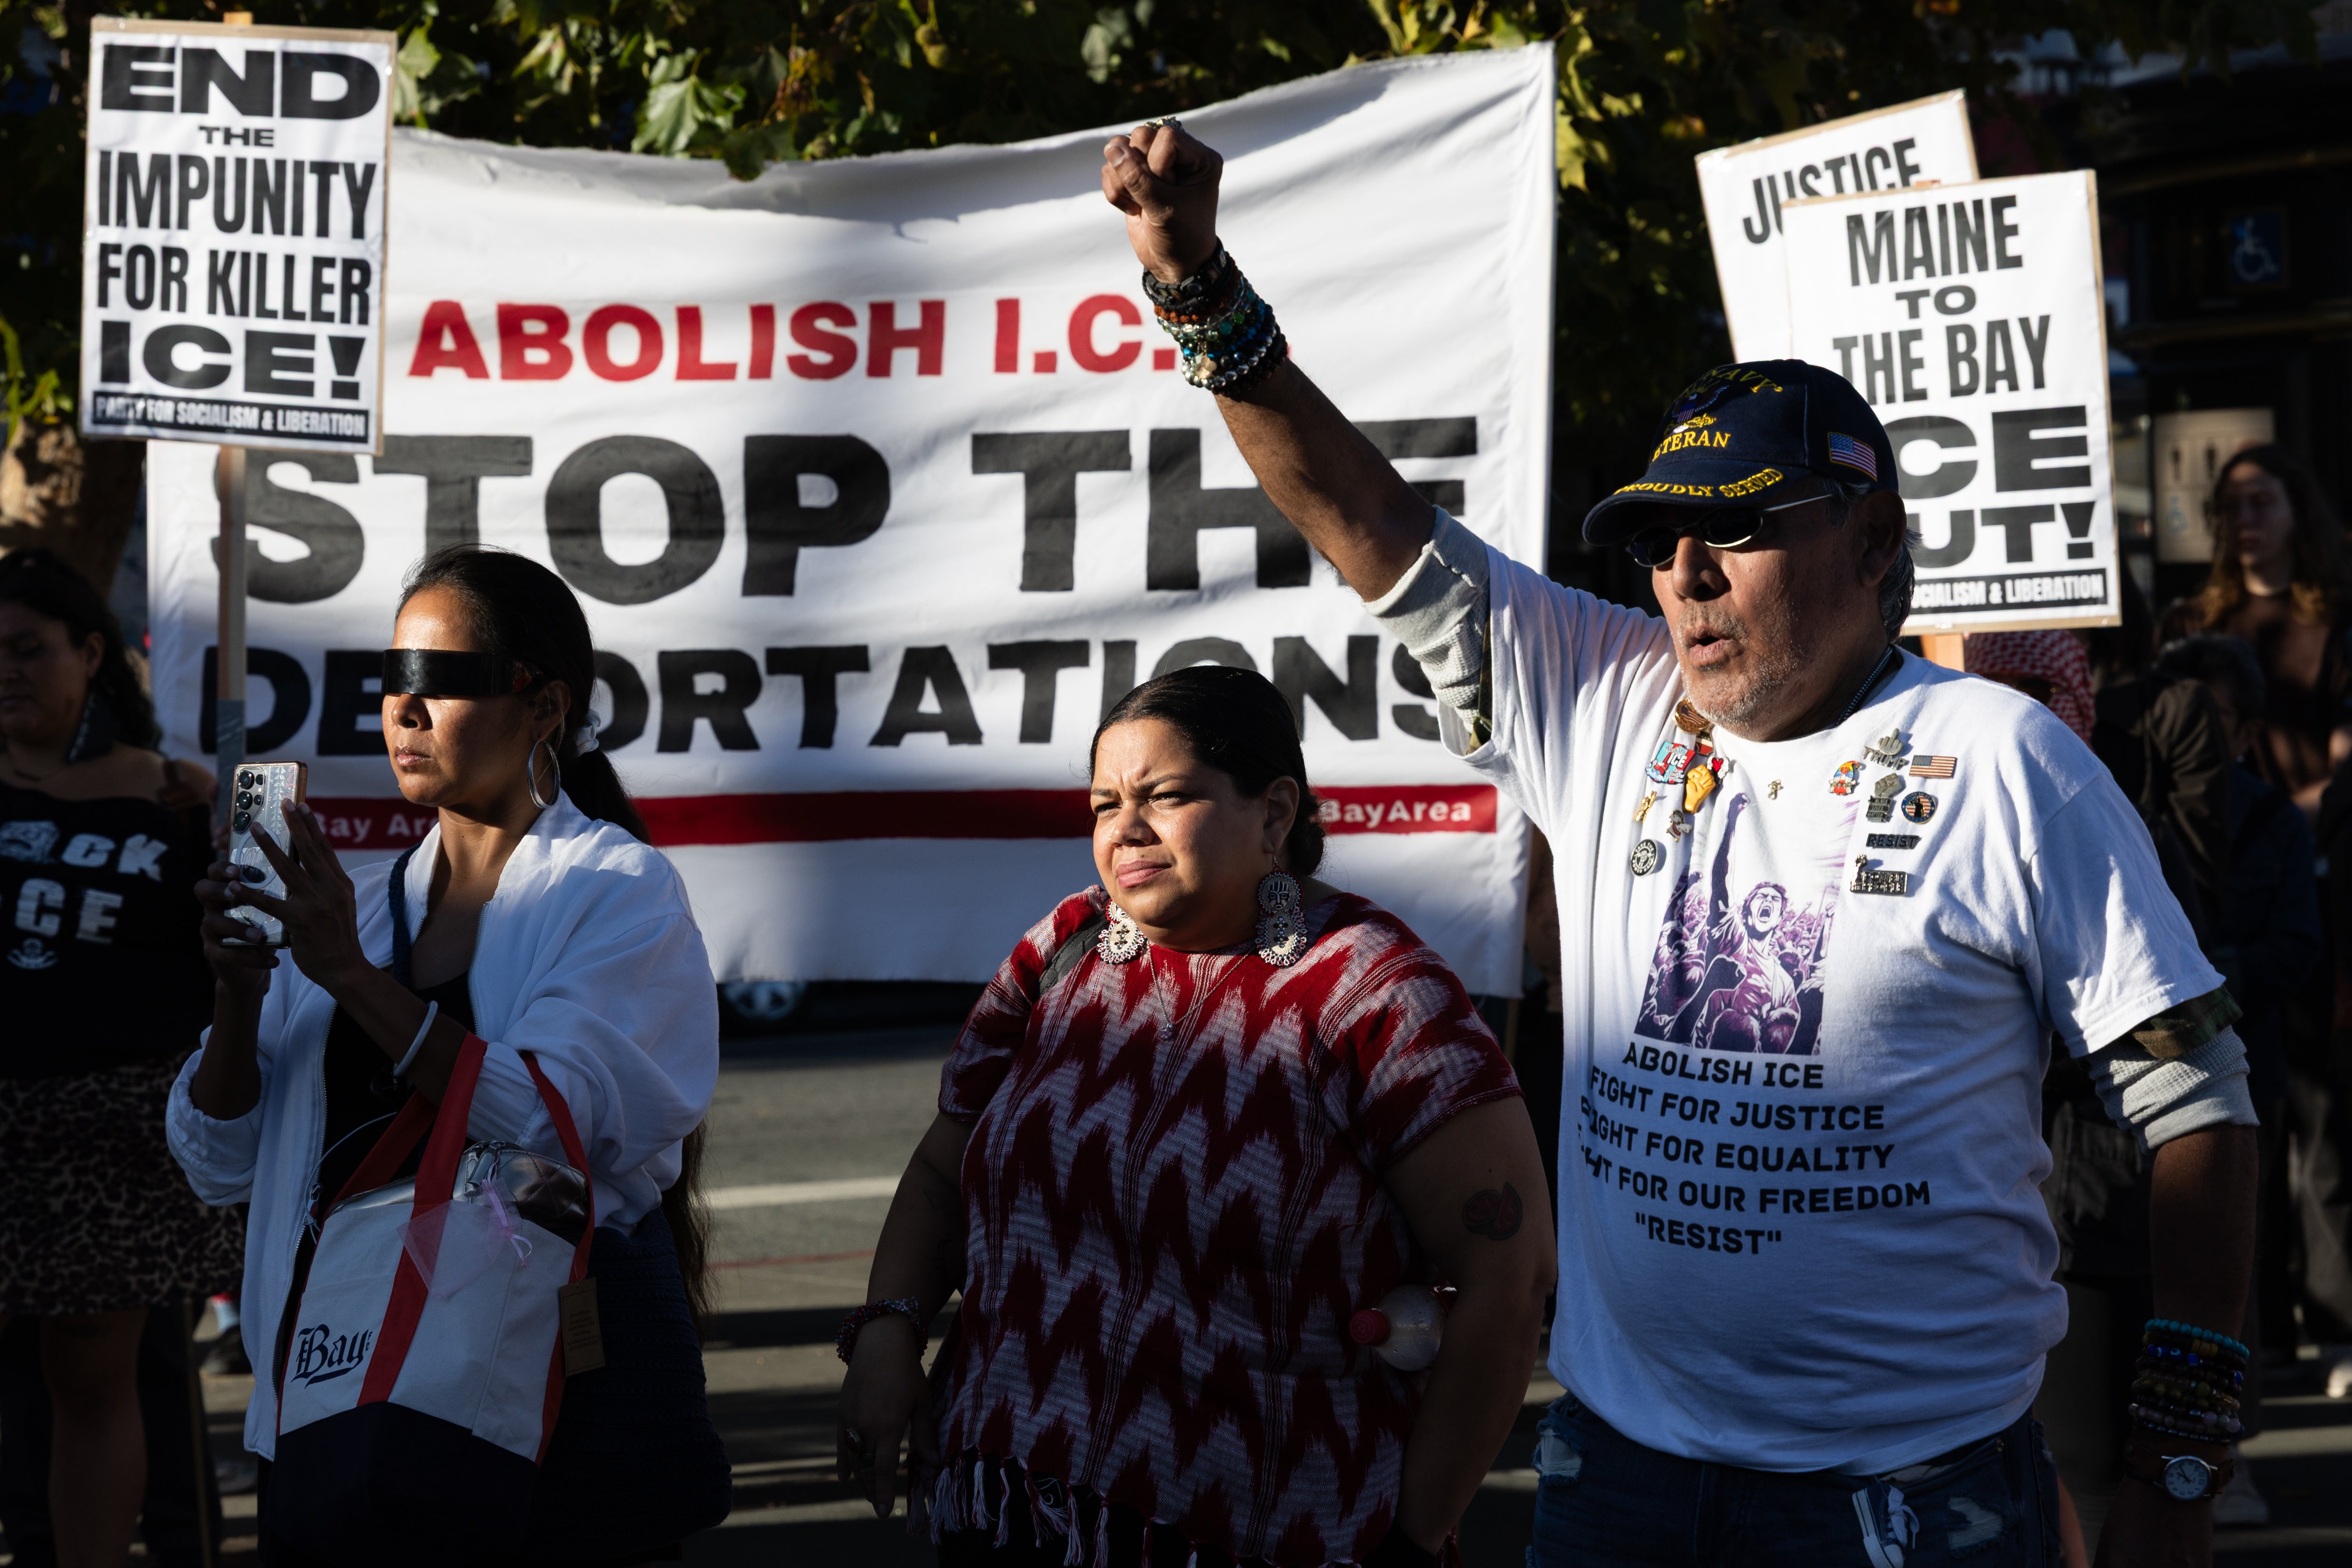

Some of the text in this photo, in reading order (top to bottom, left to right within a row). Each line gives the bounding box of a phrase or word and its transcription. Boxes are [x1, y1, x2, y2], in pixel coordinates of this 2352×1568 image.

[101, 44, 380, 120] END
[199, 126, 275, 148] THE
[98, 151, 376, 239] IMPUNITY
[1846, 195, 2023, 287] MAINE
[97, 243, 372, 326] FOR KILLER
[1894, 284, 1977, 318] TO
[100, 320, 366, 401] ICE!
[408, 294, 1176, 382] ABOLISH I.C.
[1832, 314, 2051, 406] THE BAY
[95, 396, 366, 437] PARTY FOR SOCIALISM & LIBERATION
[1652, 430, 1732, 462] ETERAN
[1882, 405, 2093, 500] CE
[1718, 469, 1784, 498] SERVED
[211, 434, 891, 606] STOP
[1908, 501, 2097, 569] UT!
[1912, 573, 2104, 609] OCIALISM & LIBERATION
[1667, 752, 1688, 768] ICE
[1863, 747, 1907, 770] TRUMP
[1867, 835, 1917, 847] RESIST
[15, 878, 123, 943] CE
[1621, 1042, 1824, 1089] ABOLISH ICE
[1590, 1065, 1885, 1130] FIGHT FOR JUSTICE
[1645, 1133, 1704, 1166] FOR
[1715, 1143, 1895, 1173] EQUALITY
[1619, 1167, 1931, 1214] FOR OUR FREEDOM
[1635, 1212, 1782, 1255] "RESIST"
[291, 1324, 369, 1389] Bay
